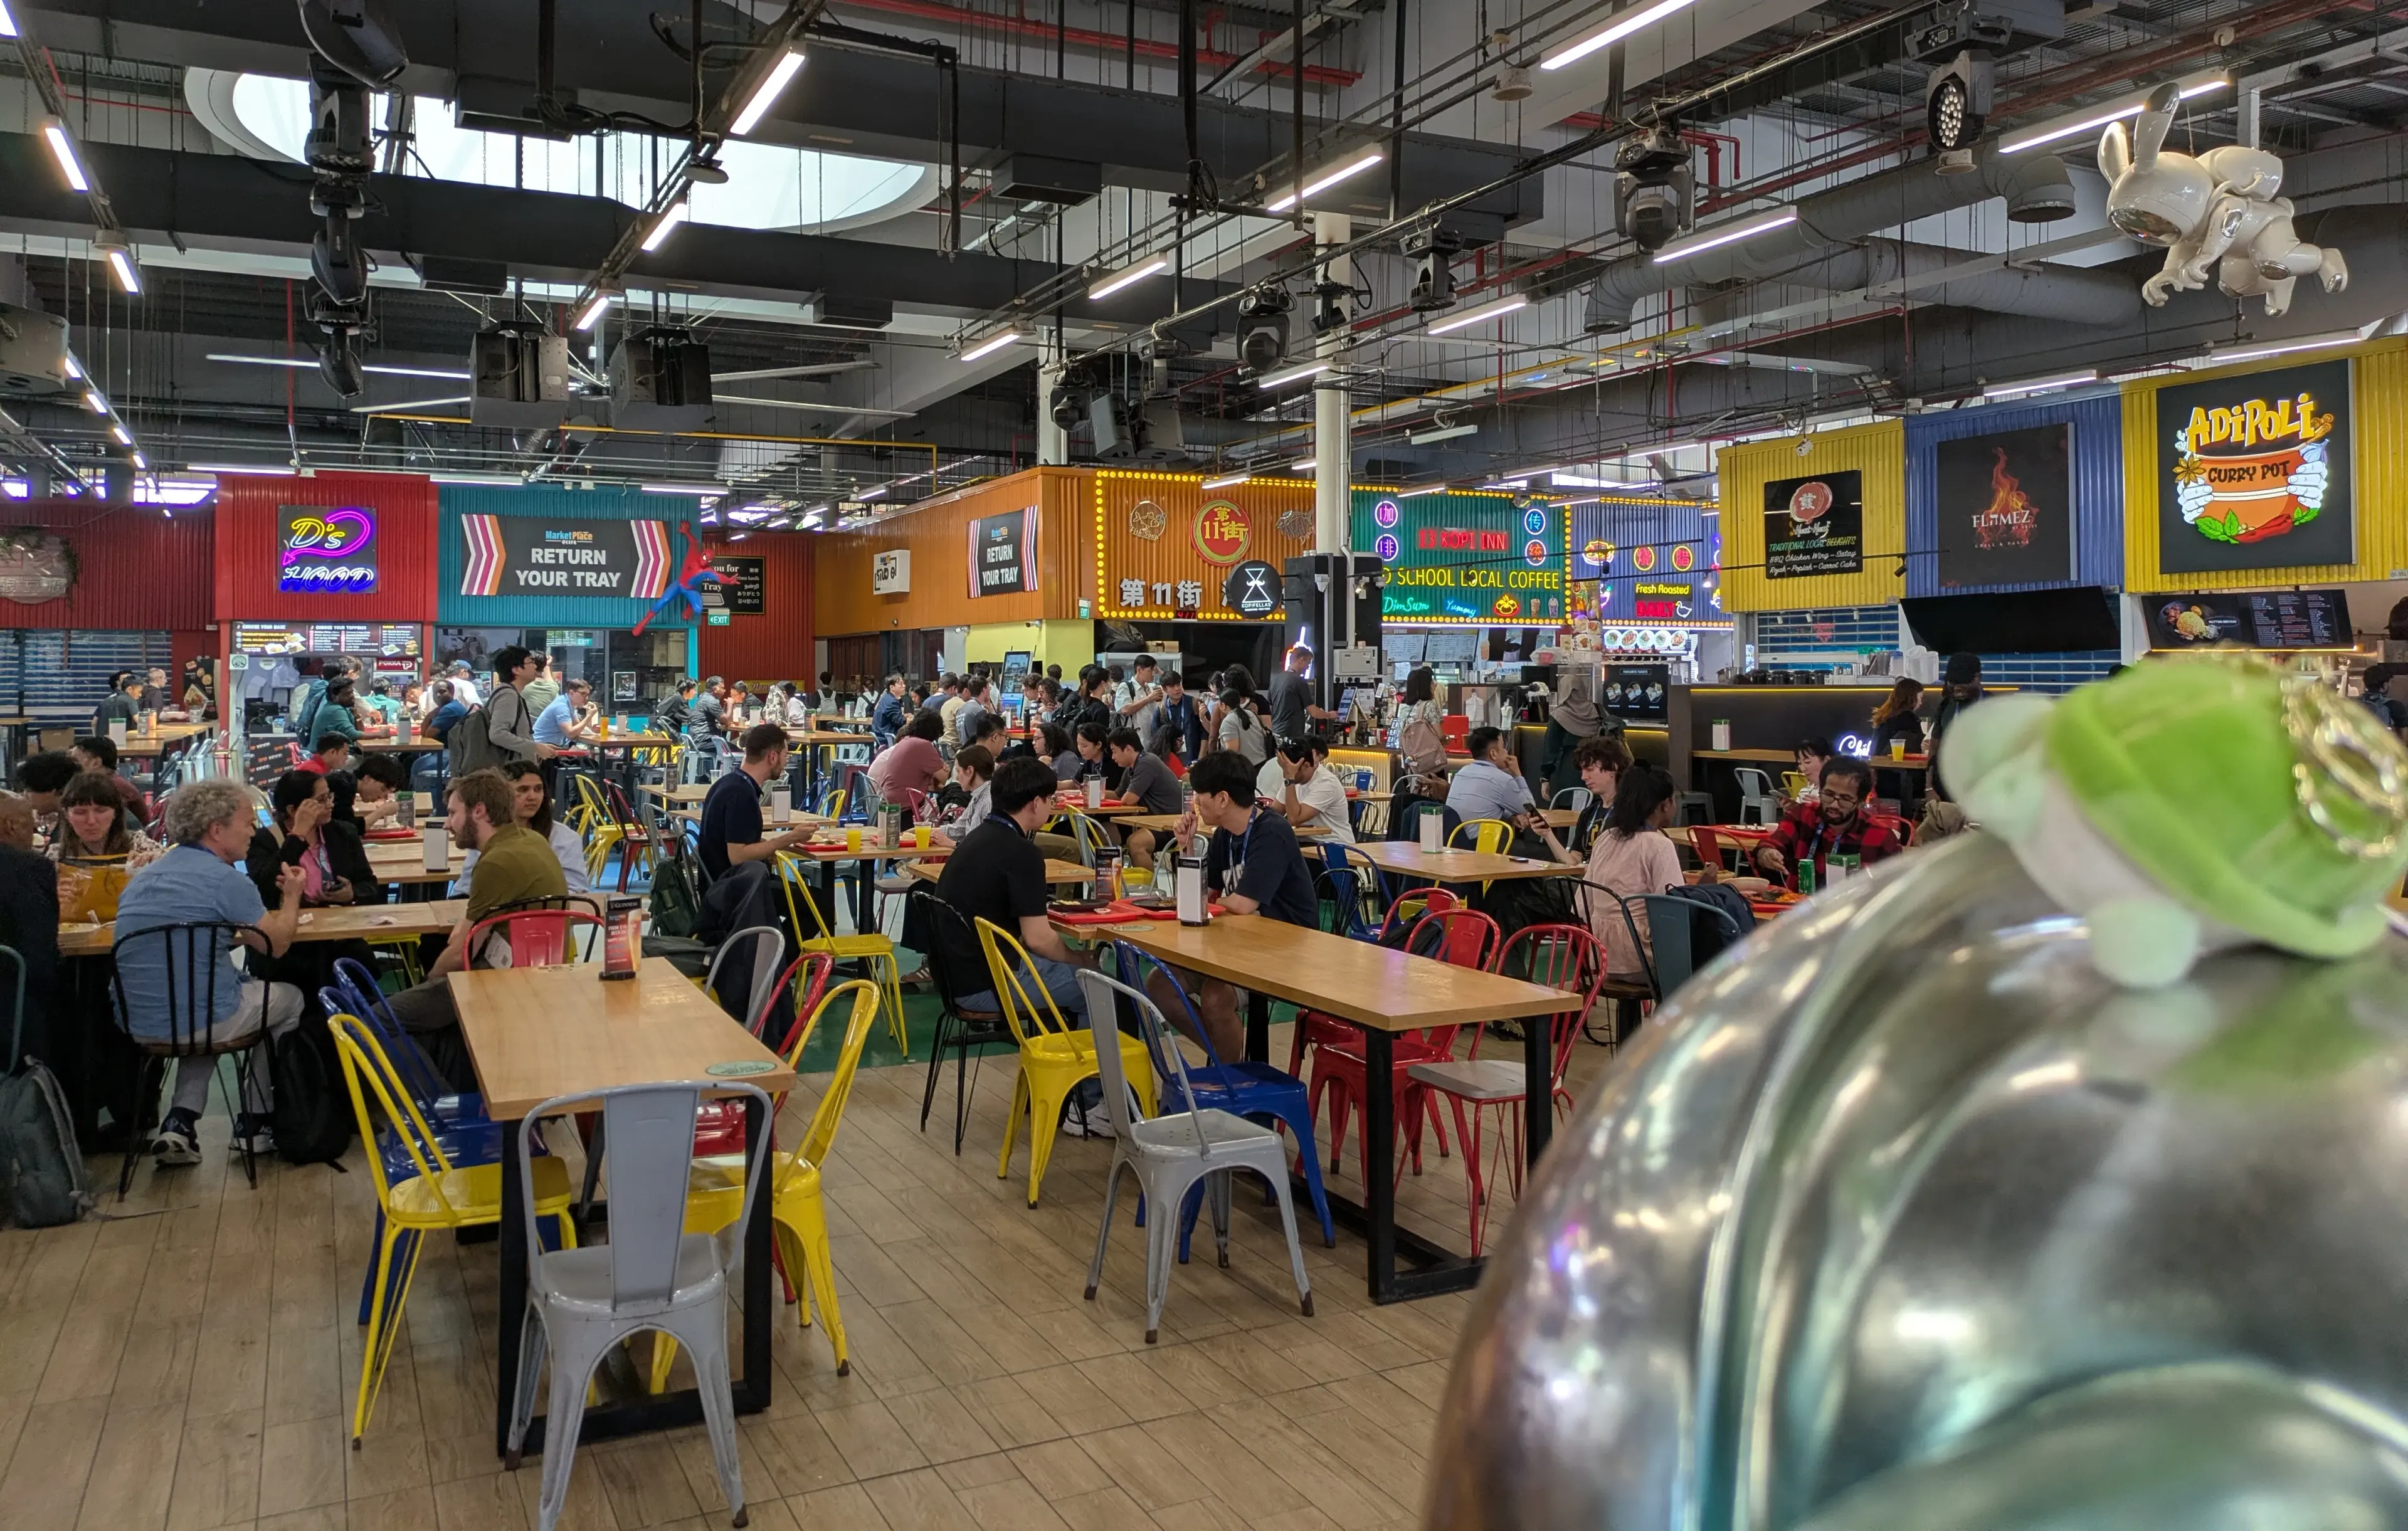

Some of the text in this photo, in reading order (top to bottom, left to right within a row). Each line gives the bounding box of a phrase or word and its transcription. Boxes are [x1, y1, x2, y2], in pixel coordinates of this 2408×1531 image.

[2208, 460, 2291, 483] CURRY POT
[1380, 505, 1394, 522] 咖
[1528, 513, 1542, 530] 传
[290, 518, 346, 549] D's
[1130, 527, 1159, 540] Fish Soup
[1418, 530, 1506, 550] 13 KOPI INN
[1380, 539, 1395, 556] 啡
[1769, 536, 1857, 552] TRADITIONAL LOCAL DELIGHTS
[531, 547, 606, 565] RETURN
[986, 543, 1013, 564] RETURN
[1676, 549, 1690, 566] 腊
[1785, 554, 1810, 562] Chicken
[1812, 552, 1829, 560] Wing
[1835, 550, 1857, 558] Satay
[726, 564, 740, 572] for
[982, 566, 1019, 587] YOUR TRAY
[1770, 566, 1787, 576] Rojak
[1791, 564, 1813, 574] Popiah
[1818, 562, 1839, 570] Carrot
[515, 570, 621, 587] YOUR TRAY
[1397, 567, 1455, 586] SCHOOL
[1460, 569, 1504, 587] LOCAL
[1509, 571, 1560, 589] COFFEE
[702, 582, 723, 592] Tray
[1635, 584, 1689, 594] Fresh Roasted
[1080, 608, 1089, 617] EXIT
[1445, 599, 1476, 618] Yummy
[1636, 601, 1675, 618] DAILY
[714, 616, 727, 624] EXIT
[578, 638, 590, 646] EXIT
